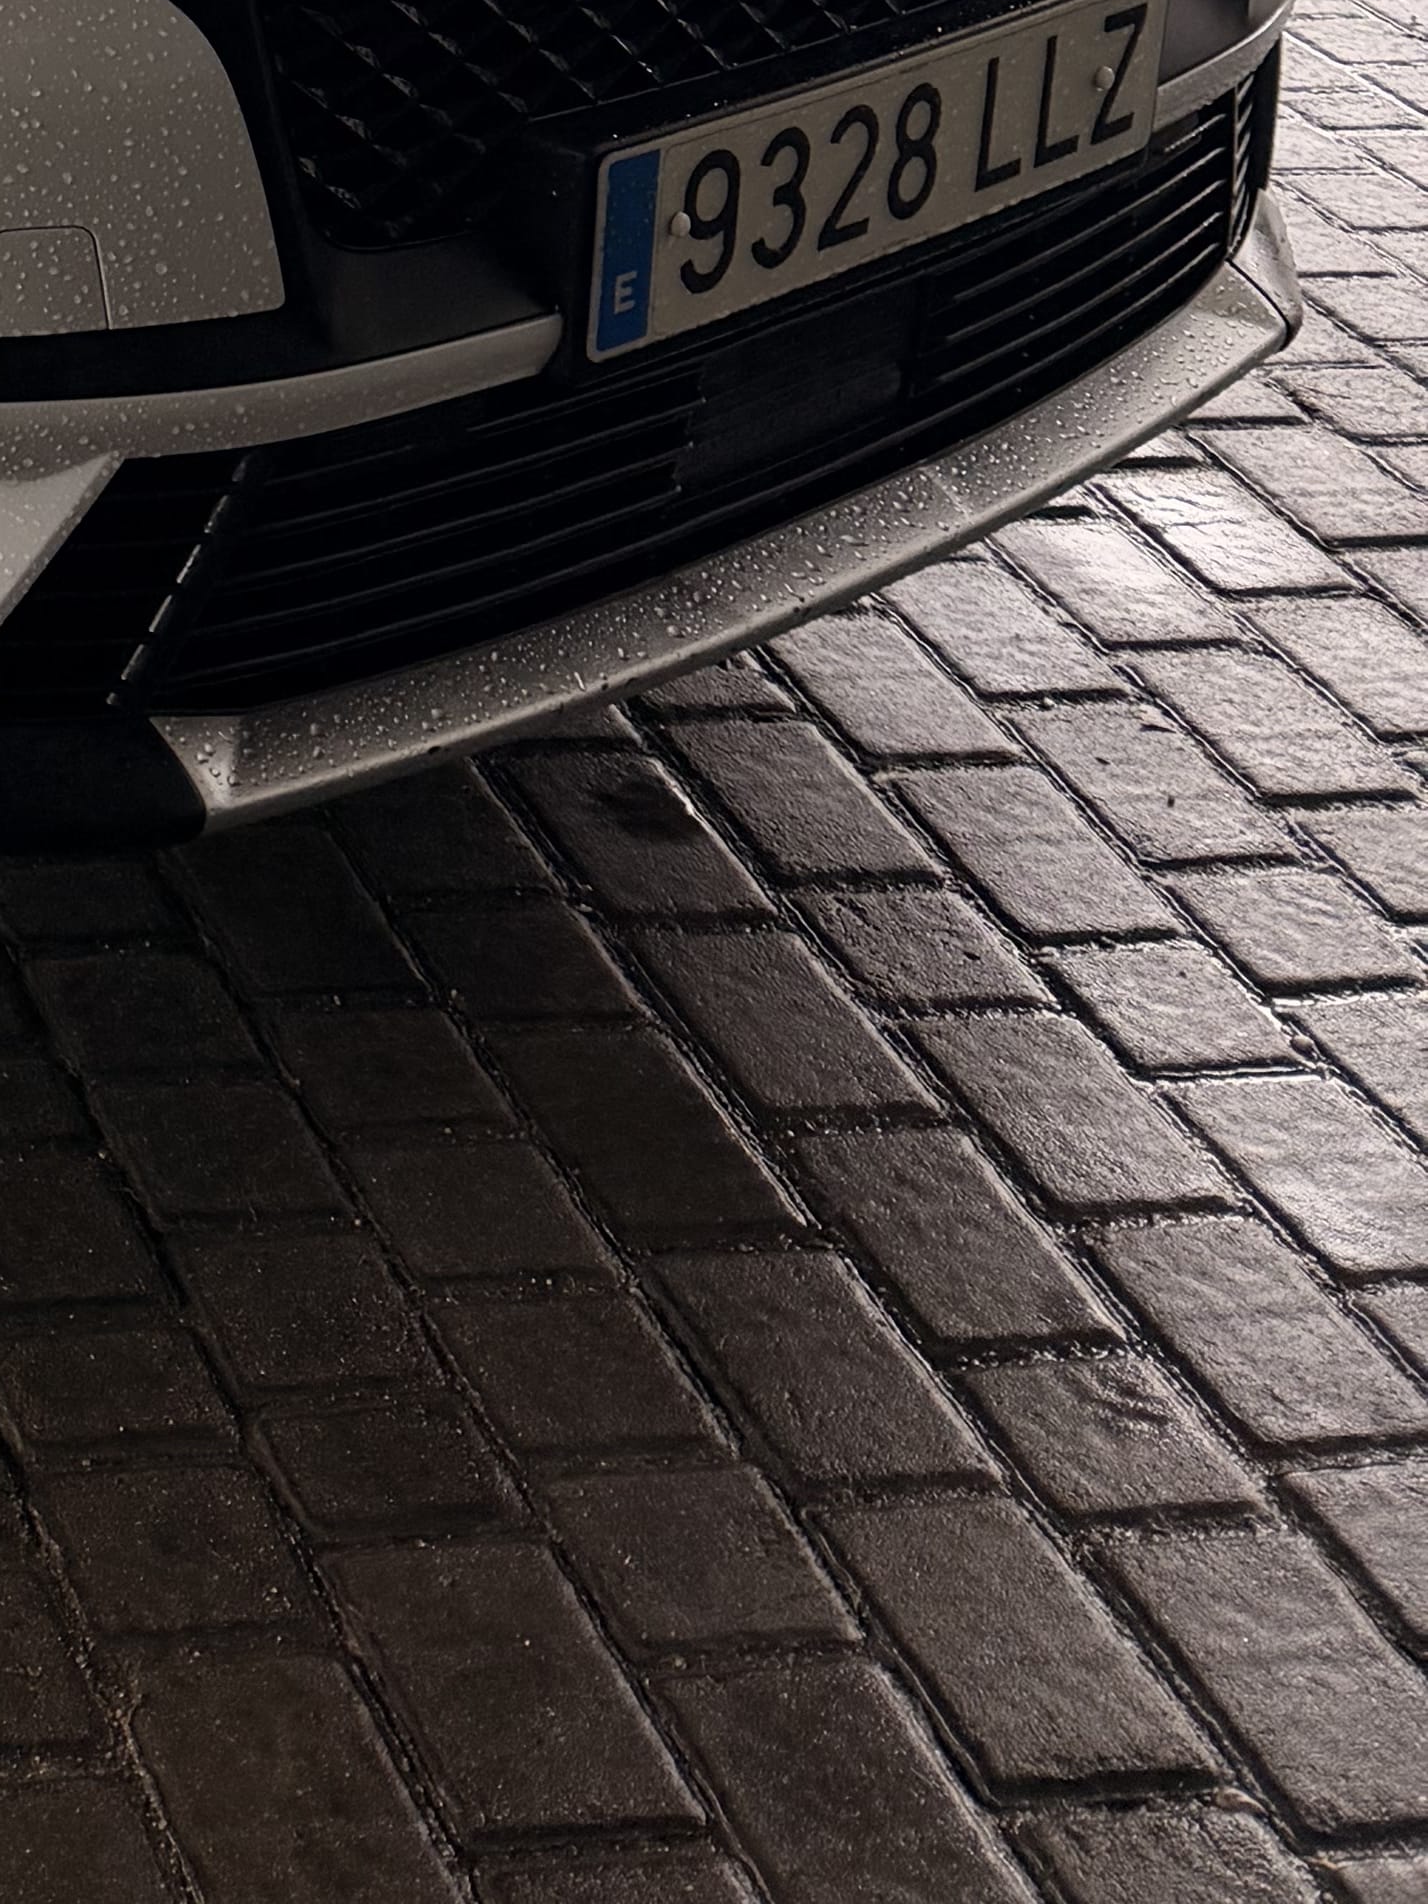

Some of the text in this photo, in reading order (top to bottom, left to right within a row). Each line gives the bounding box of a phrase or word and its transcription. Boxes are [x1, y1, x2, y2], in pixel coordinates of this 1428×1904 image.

[679, 3, 1148, 294] 9328 LLZ
[614, 270, 638, 315] E
